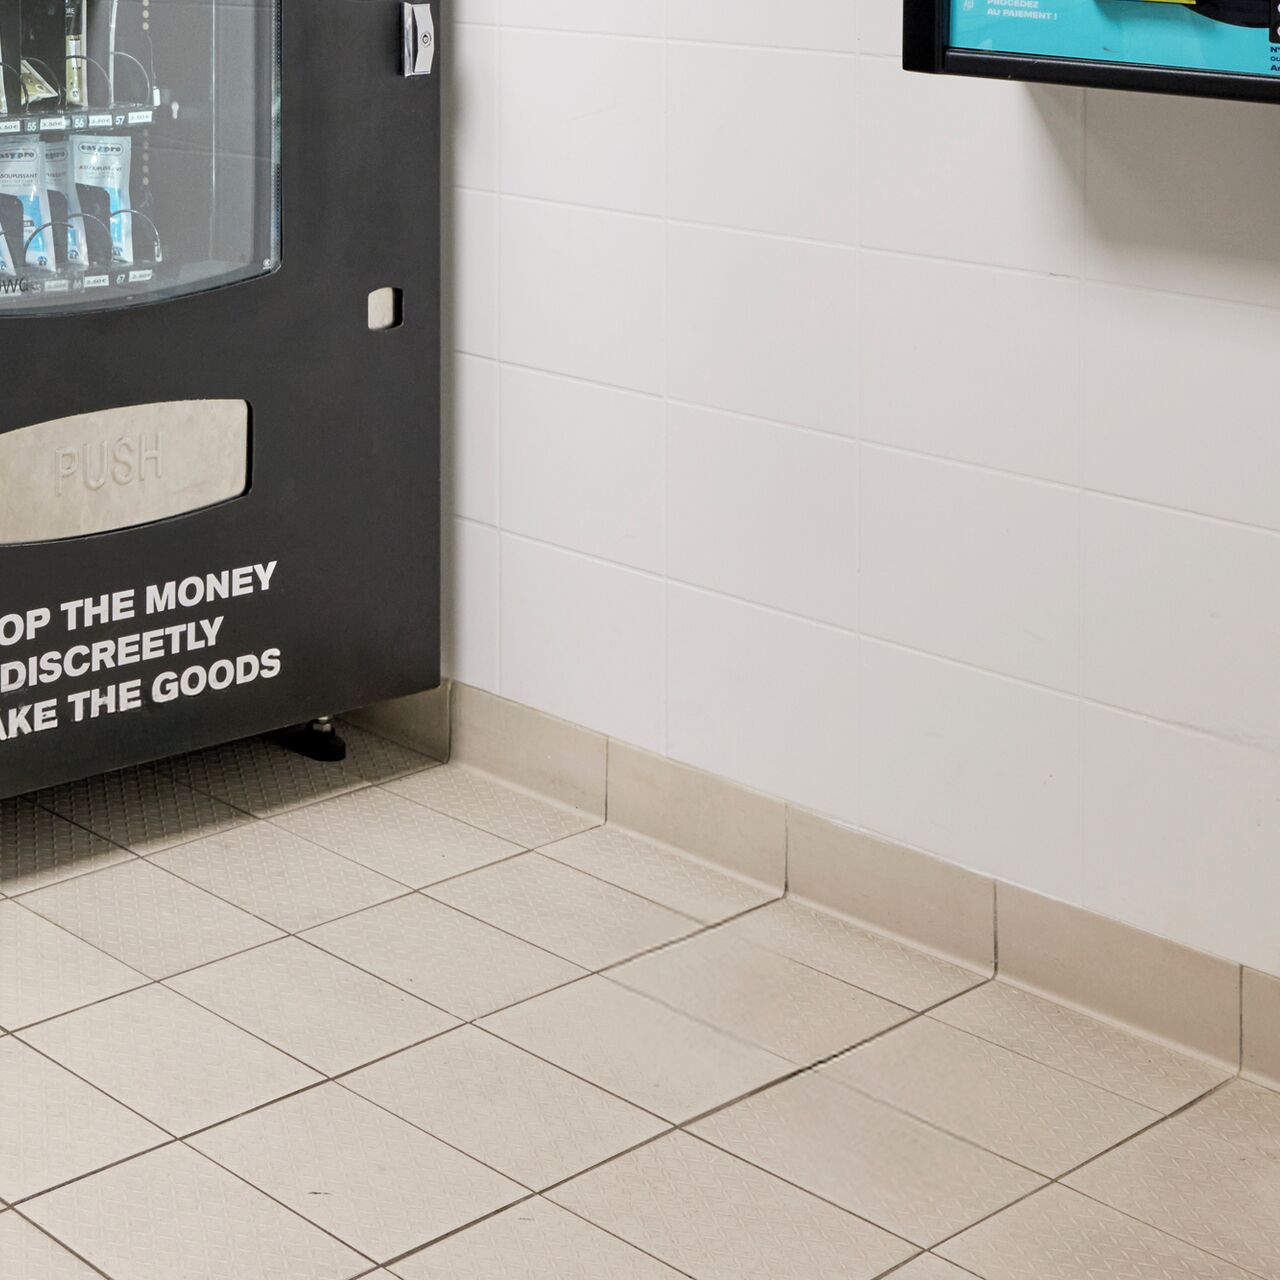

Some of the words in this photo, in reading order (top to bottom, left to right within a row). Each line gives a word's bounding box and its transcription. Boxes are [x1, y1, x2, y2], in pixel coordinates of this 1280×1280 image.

[987, 8, 1001, 16] AU
[1003, 9, 1052, 20] PAIEMENT
[54, 431, 163, 497] PUSH
[60, 589, 135, 631] THE
[145, 560, 278, 614] MONEY
[0, 616, 224, 693] DISCREETLY
[67, 678, 141, 722] THE
[151, 648, 281, 704] GOODS
